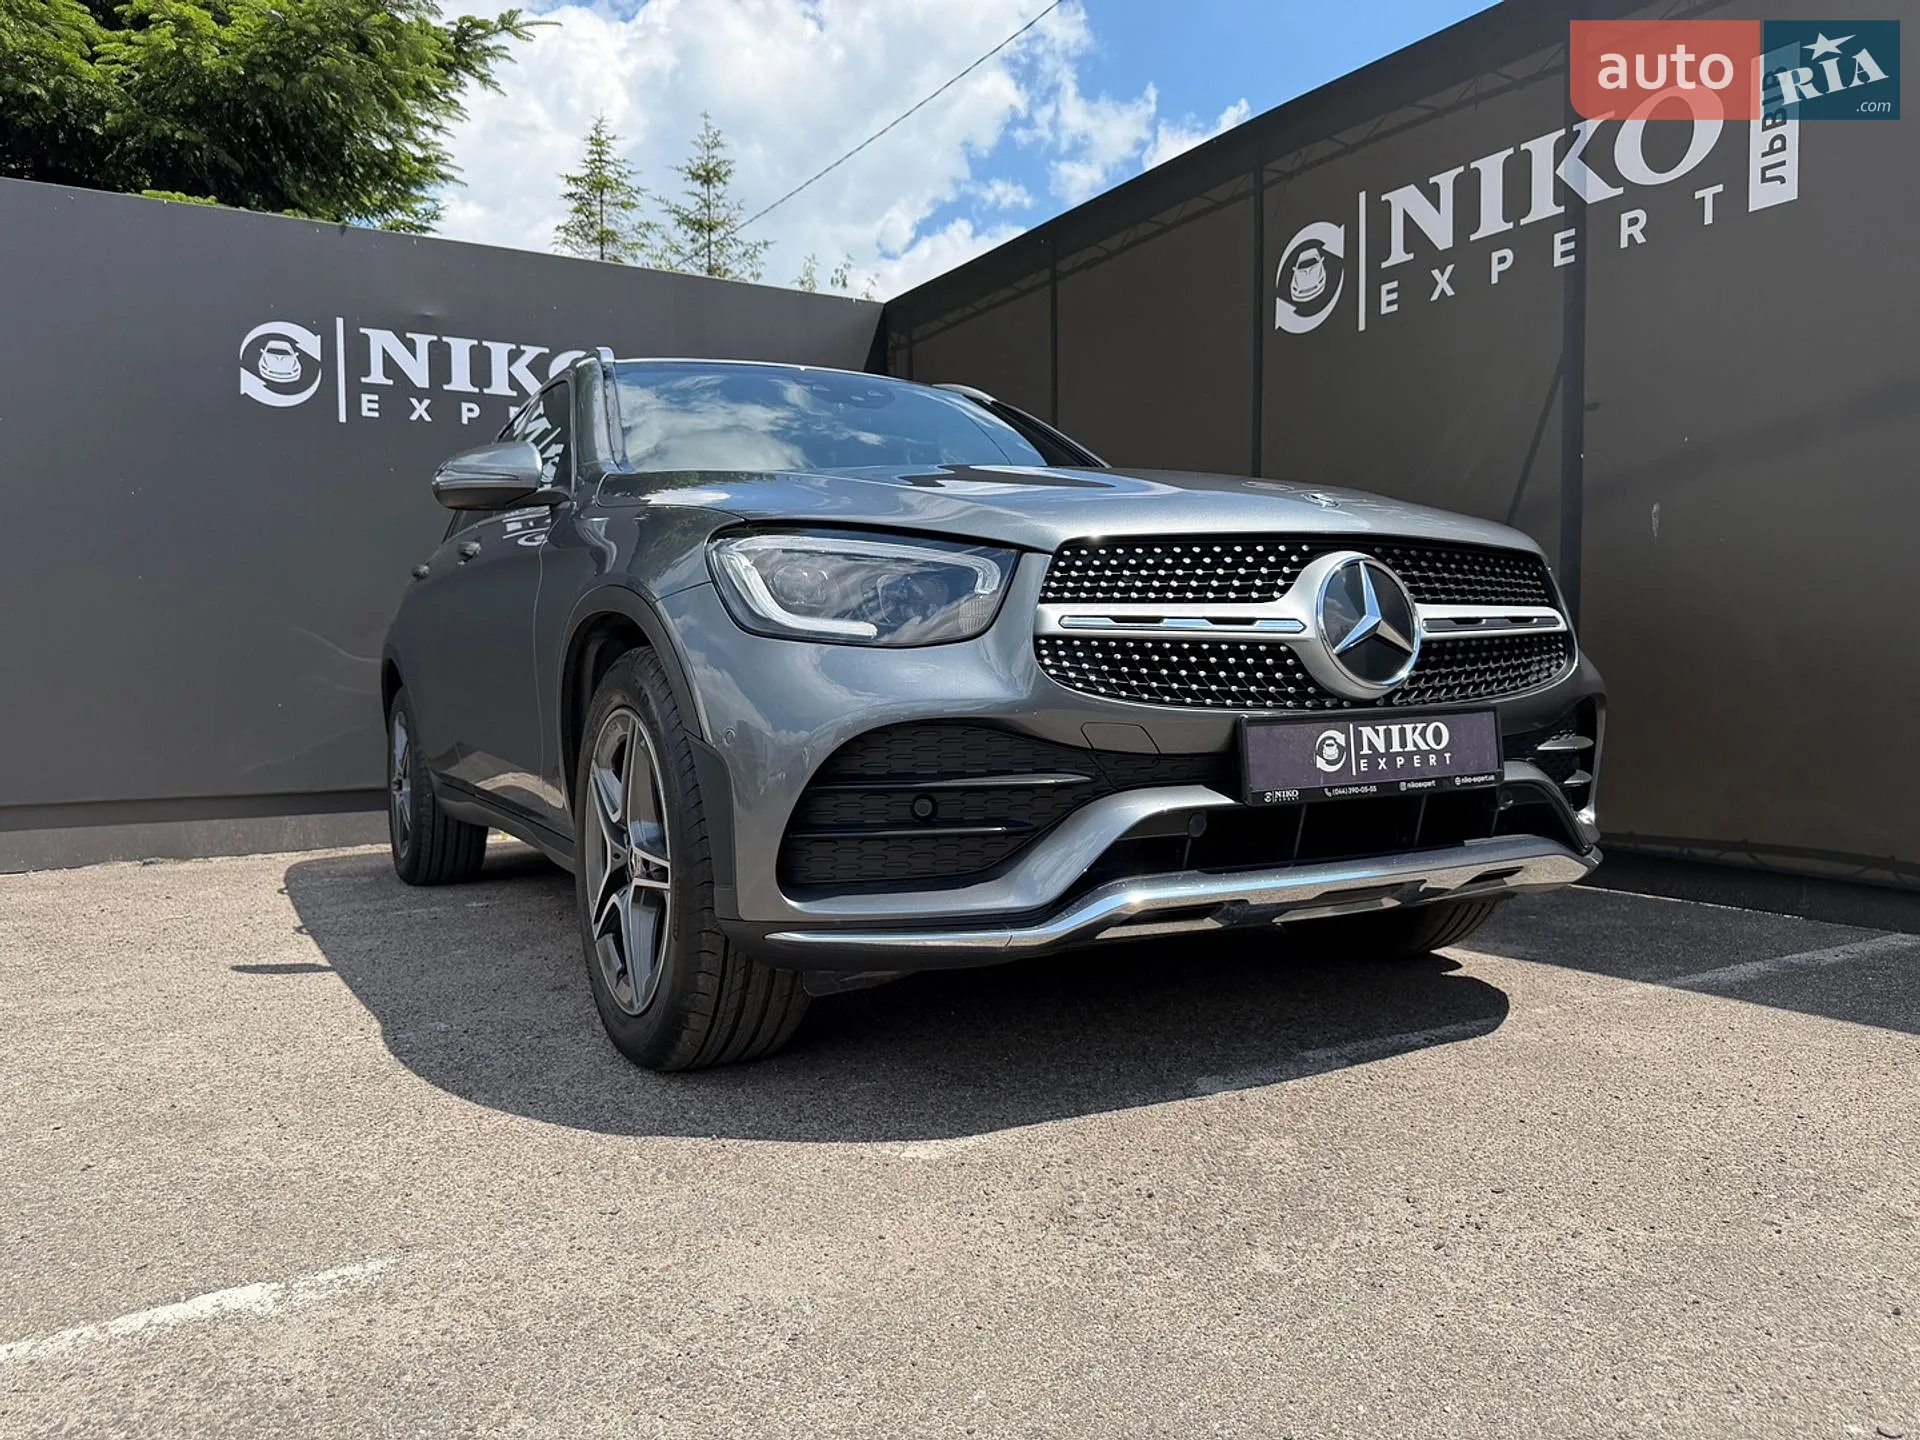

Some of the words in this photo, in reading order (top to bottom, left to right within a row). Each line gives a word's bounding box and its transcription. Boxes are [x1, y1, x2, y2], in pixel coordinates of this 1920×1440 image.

[1380, 83, 1725, 269] NIKO
[1379, 183, 1725, 316] EXPERT
[1358, 721, 1450, 755] NIKO
[1359, 752, 1452, 772] EXPERT
[1274, 789, 1299, 799] NIKO
